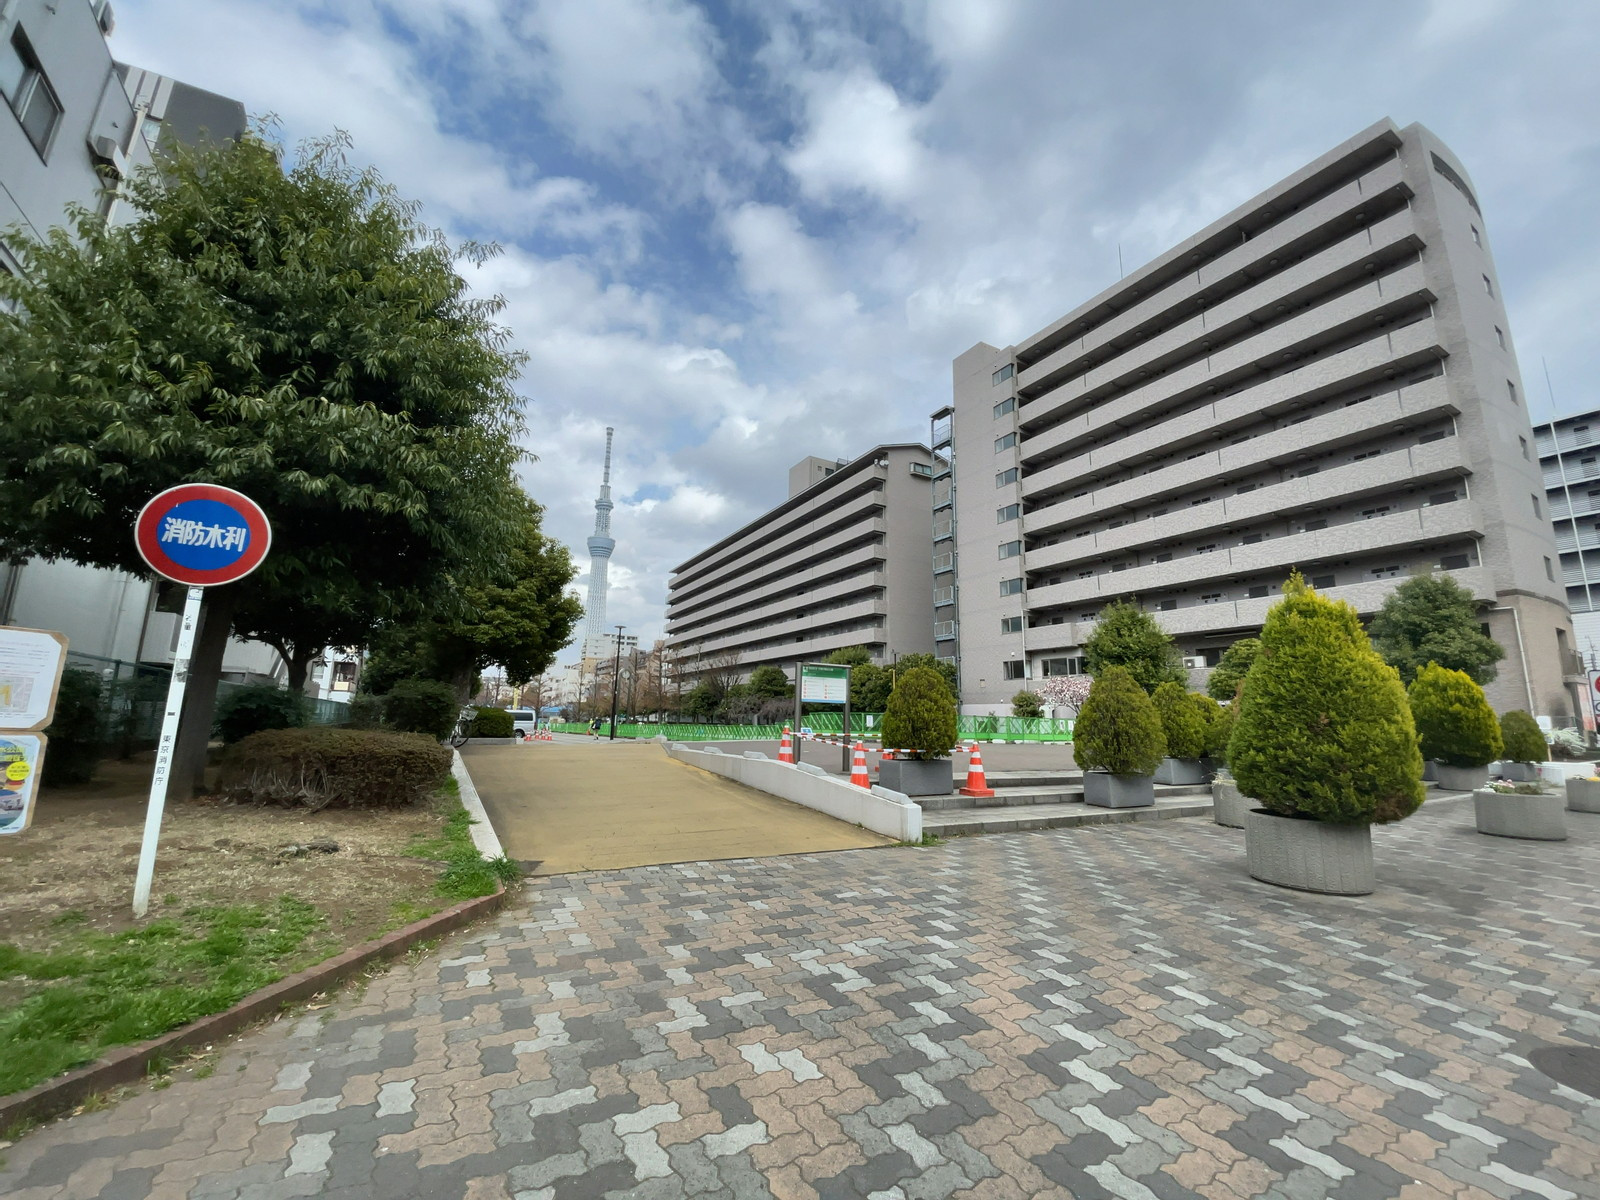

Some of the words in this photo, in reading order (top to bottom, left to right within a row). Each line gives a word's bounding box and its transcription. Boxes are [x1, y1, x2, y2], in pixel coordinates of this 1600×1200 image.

[161, 516, 247, 553] 消防水利
[154, 734, 172, 785] 東京消防庁
